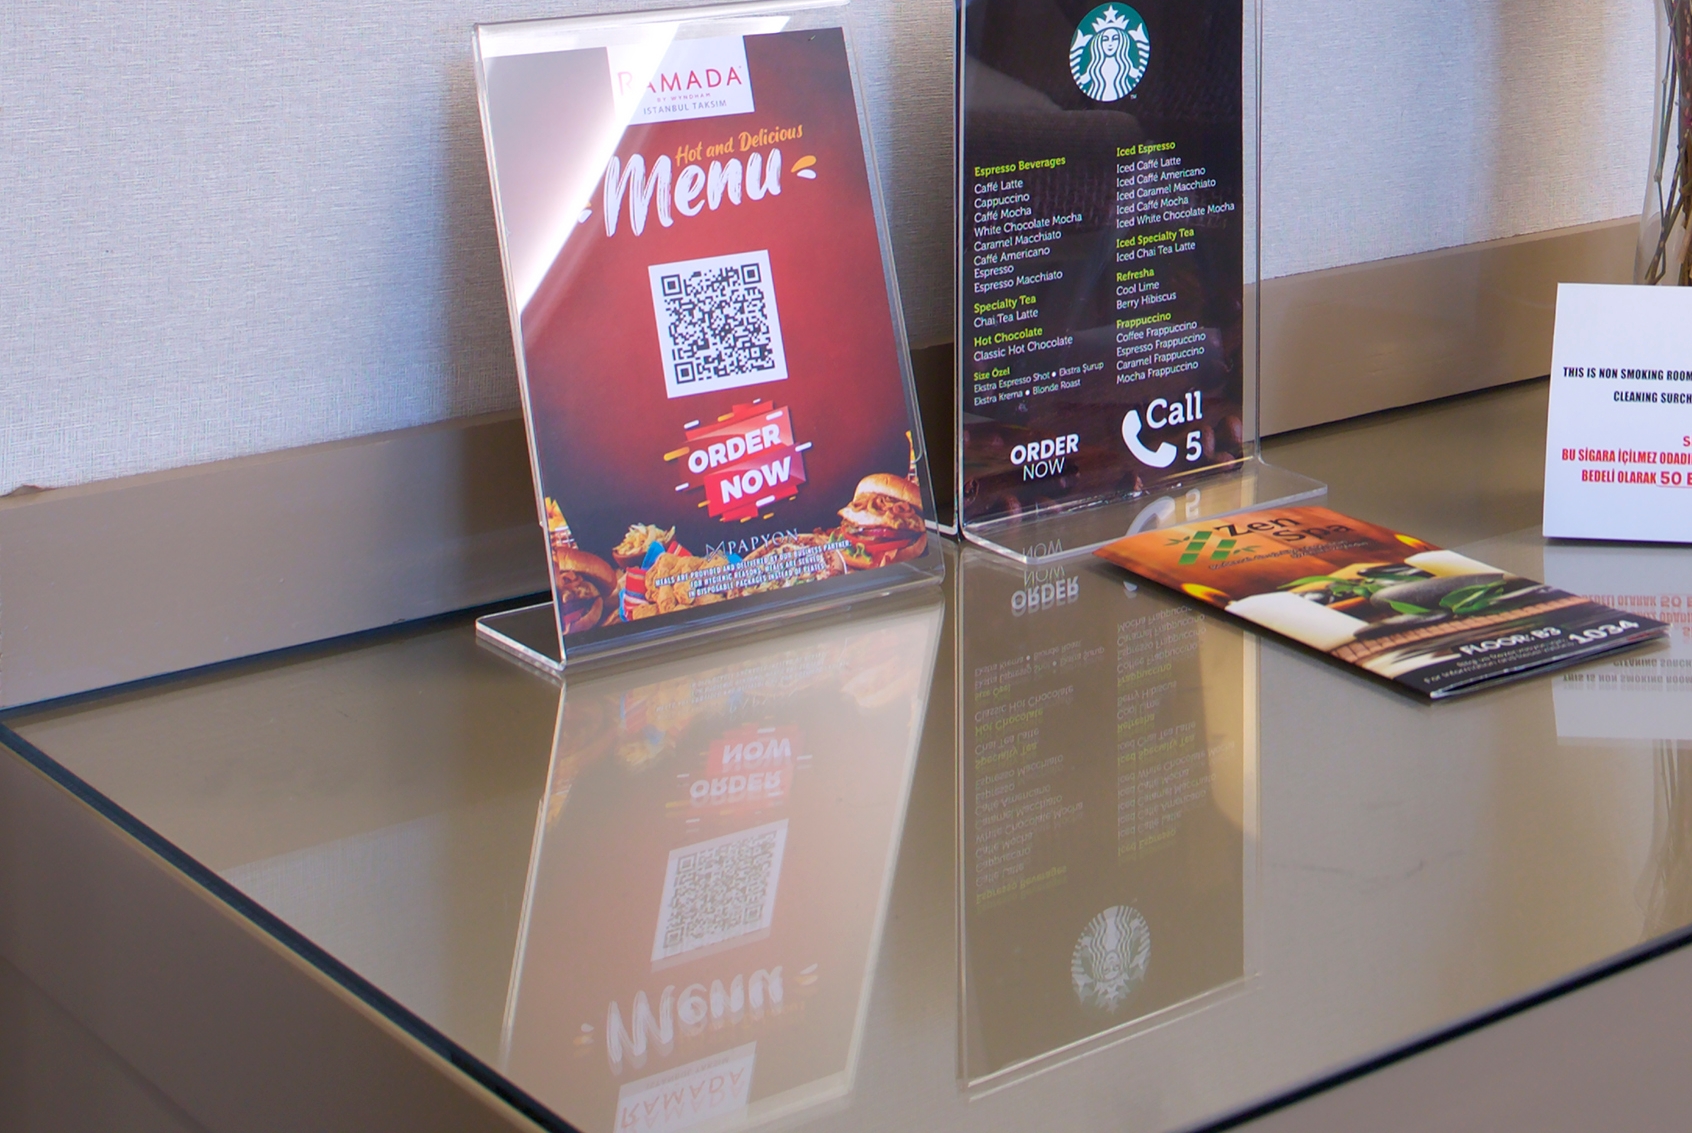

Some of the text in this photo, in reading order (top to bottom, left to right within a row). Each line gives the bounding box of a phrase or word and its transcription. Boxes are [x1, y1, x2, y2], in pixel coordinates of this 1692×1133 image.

[643, 100, 727, 115] ISTANBUL TAKSIM
[675, 124, 803, 166] Hot and Delicious
[1117, 142, 1175, 157] Iced Espresso
[974, 156, 1066, 177] Espresso Beverages
[1117, 157, 1181, 173] Iced Caffé Latte
[974, 179, 1023, 194] Caffé Latte
[1117, 168, 1206, 187] Iced Caffé Americano
[604, 148, 782, 237] Menu
[1117, 179, 1216, 201] Iced Caramel Macchiato
[974, 193, 1030, 209] Cappuccino
[1117, 196, 1189, 215] Iced Caffé Mocha
[974, 207, 1032, 223] Caffé Mocha
[1117, 202, 1235, 229] Iced White Chocolate Mocha
[974, 213, 1082, 238] White Chocolate Mocha
[974, 230, 1062, 252] Caramel Macchiato
[1117, 228, 1194, 248] Iced Specialty Tea
[974, 247, 1051, 266] Caffé Americano
[1117, 242, 1196, 263] Iced Chai Tea Latte
[974, 265, 1014, 280] Espresso
[974, 270, 1063, 294] Espresso Macchiato
[1116, 268, 1155, 282] Refresha
[1116, 281, 1159, 296] Cool Lime
[974, 295, 1036, 315] Specialty Tea
[1116, 292, 1176, 310] Berry Hibiscus
[974, 309, 1038, 328] Chai Tea Latte
[1116, 312, 1171, 329] Frappuccino
[974, 328, 1043, 347] Hot Chocolate
[1116, 321, 1197, 343] Coffee Frappuccino
[974, 335, 1074, 362] Classic Hot Chocolate
[1117, 333, 1206, 357] Espresso Frappuccino
[1117, 347, 1204, 370] Caramel Frappuccino
[998, 376, 1032, 388] Espresso
[1033, 372, 1050, 382] Shot
[1117, 361, 1198, 384] Mocha Frappuccino
[1563, 367, 1584, 378] THIS
[1586, 367, 1596, 378] IS
[1600, 368, 1618, 379] NON
[1621, 369, 1664, 381] SMOKING
[1667, 370, 1692, 381] ROOM
[1613, 391, 1658, 403] CLEANING
[1146, 390, 1203, 429] Call
[688, 423, 782, 474] ORDER
[1010, 433, 1080, 466] ORDER
[1185, 430, 1202, 462] 5
[1562, 449, 1576, 461] BU
[1578, 447, 1615, 462] SİGARA
[1618, 448, 1657, 465] İÇİLMEZ
[1023, 456, 1066, 481] NOW
[1582, 469, 1615, 482] BEDELİ
[1618, 471, 1657, 484] OLARAK
[1661, 471, 1682, 485] 50
[720, 456, 791, 504] NOW
[1213, 518, 1300, 537] Zen
[1272, 524, 1351, 542] Spa
[728, 528, 799, 555] PAPYON
[1569, 619, 1639, 645] 1034
